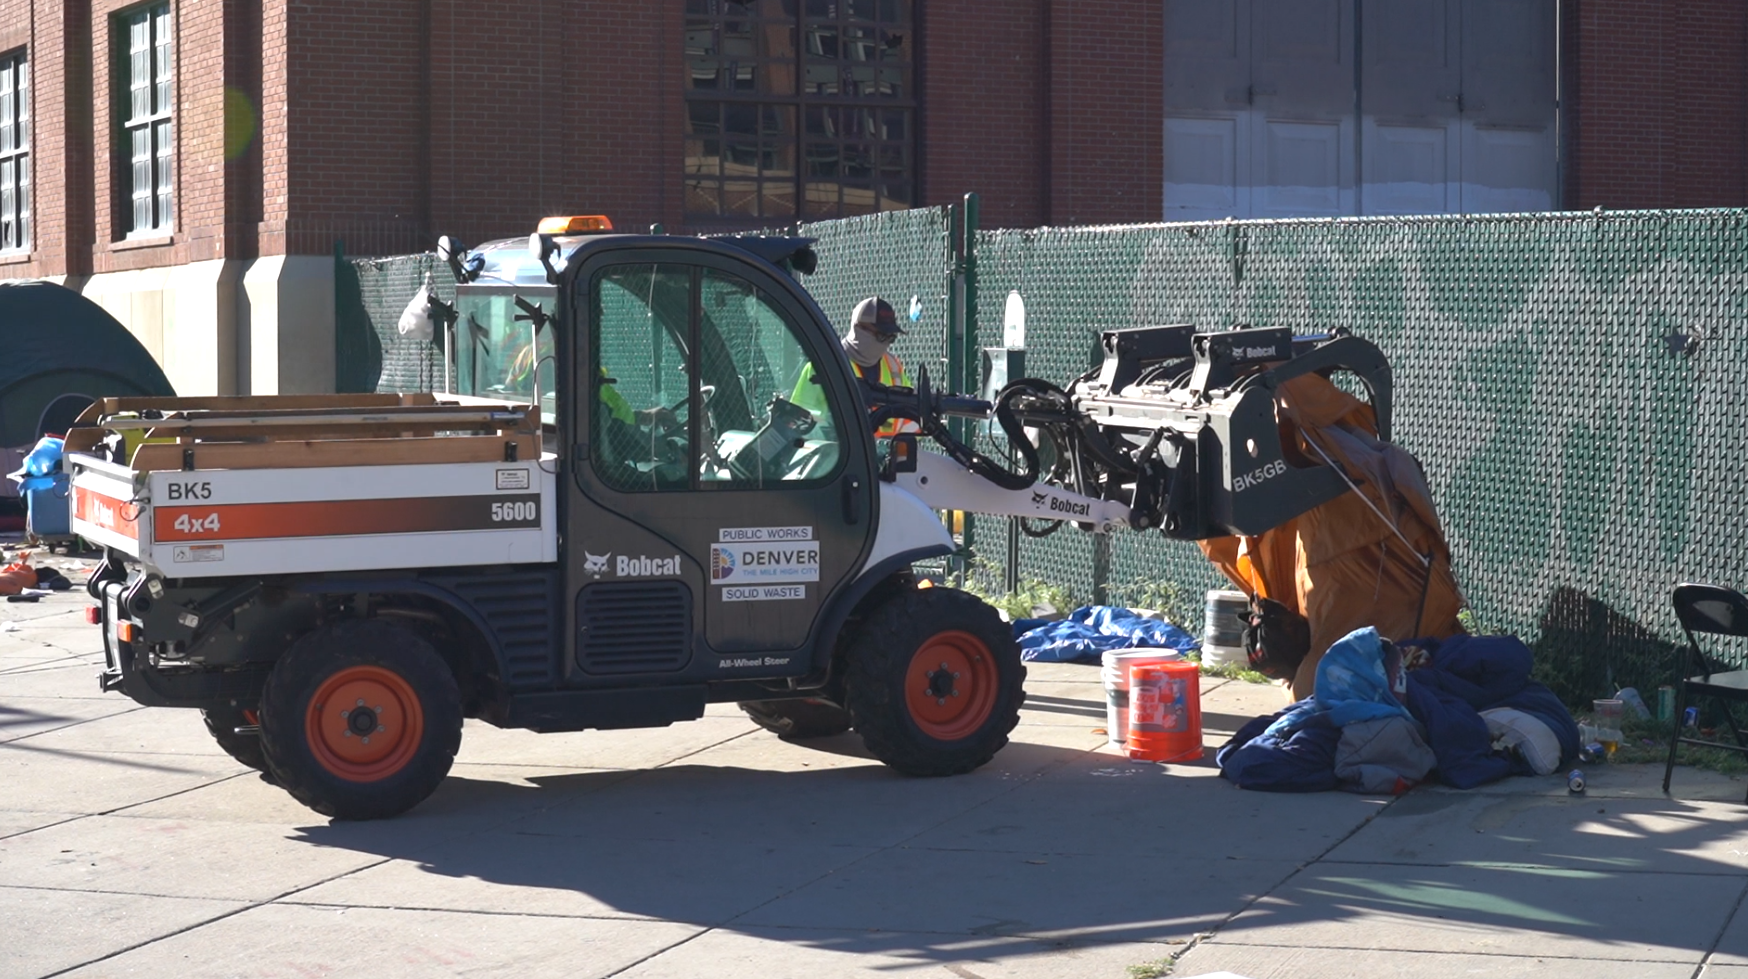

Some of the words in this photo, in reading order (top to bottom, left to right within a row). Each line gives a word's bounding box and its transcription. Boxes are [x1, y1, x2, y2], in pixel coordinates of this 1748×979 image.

[1246, 345, 1277, 359] Bobcat
[1232, 459, 1287, 492] BK5GB
[168, 482, 212, 500] BK5
[491, 501, 536, 522] 5600
[1050, 496, 1091, 516] Bobcat
[174, 513, 220, 533] 4x4
[722, 529, 763, 540] PUBLIC
[767, 528, 809, 539] WORKS
[616, 555, 681, 576] Bobcat
[742, 550, 818, 566] DENVER
[742, 569, 757, 577] THE
[760, 568, 777, 576] MILE
[780, 568, 799, 576] HIGH
[801, 567, 818, 575] CITY
[726, 588, 760, 600] SOLID
[763, 587, 801, 598] WASTE
[719, 658, 762, 669] All-Wheel
[764, 657, 790, 666] Steer
